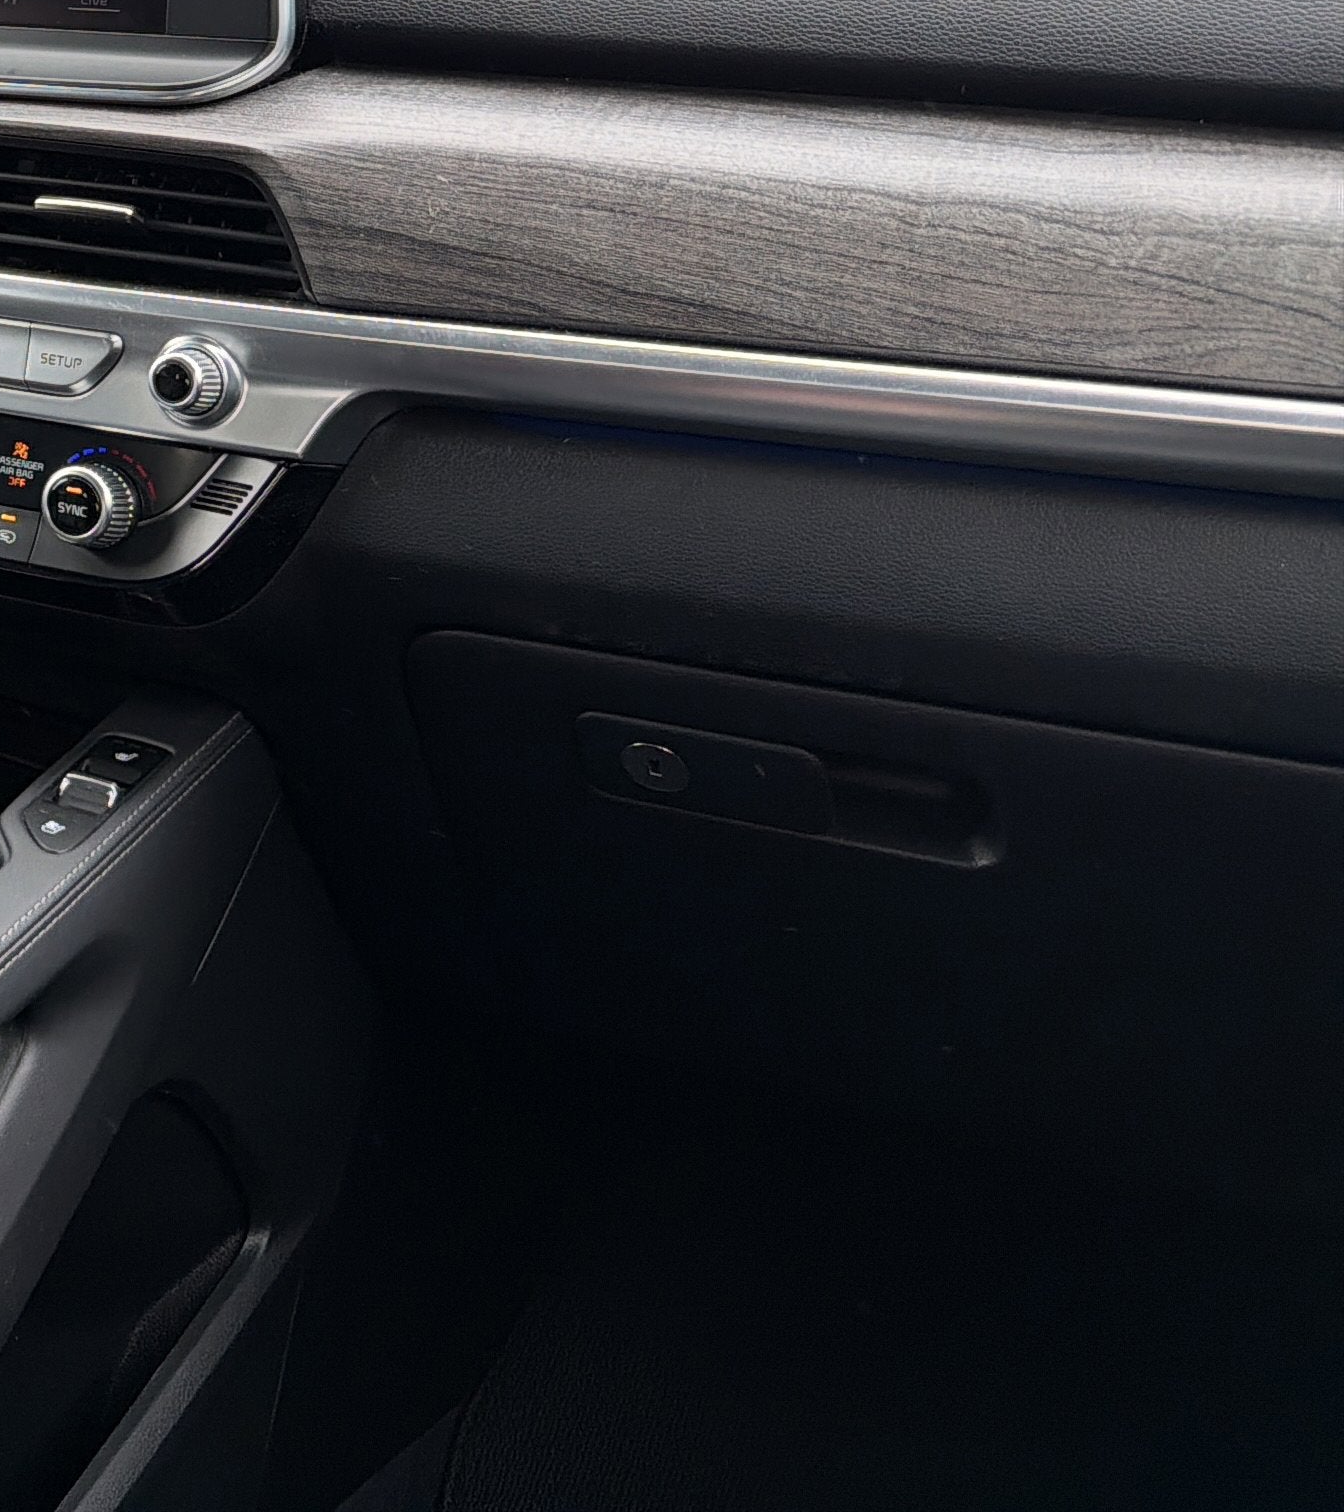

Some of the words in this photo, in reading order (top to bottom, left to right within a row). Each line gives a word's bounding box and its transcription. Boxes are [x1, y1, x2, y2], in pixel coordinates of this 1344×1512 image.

[40, 352, 83, 369] SETUP
[0, 465, 14, 475] AIR
[15, 469, 34, 480] BAG
[57, 501, 88, 518] SYNC
